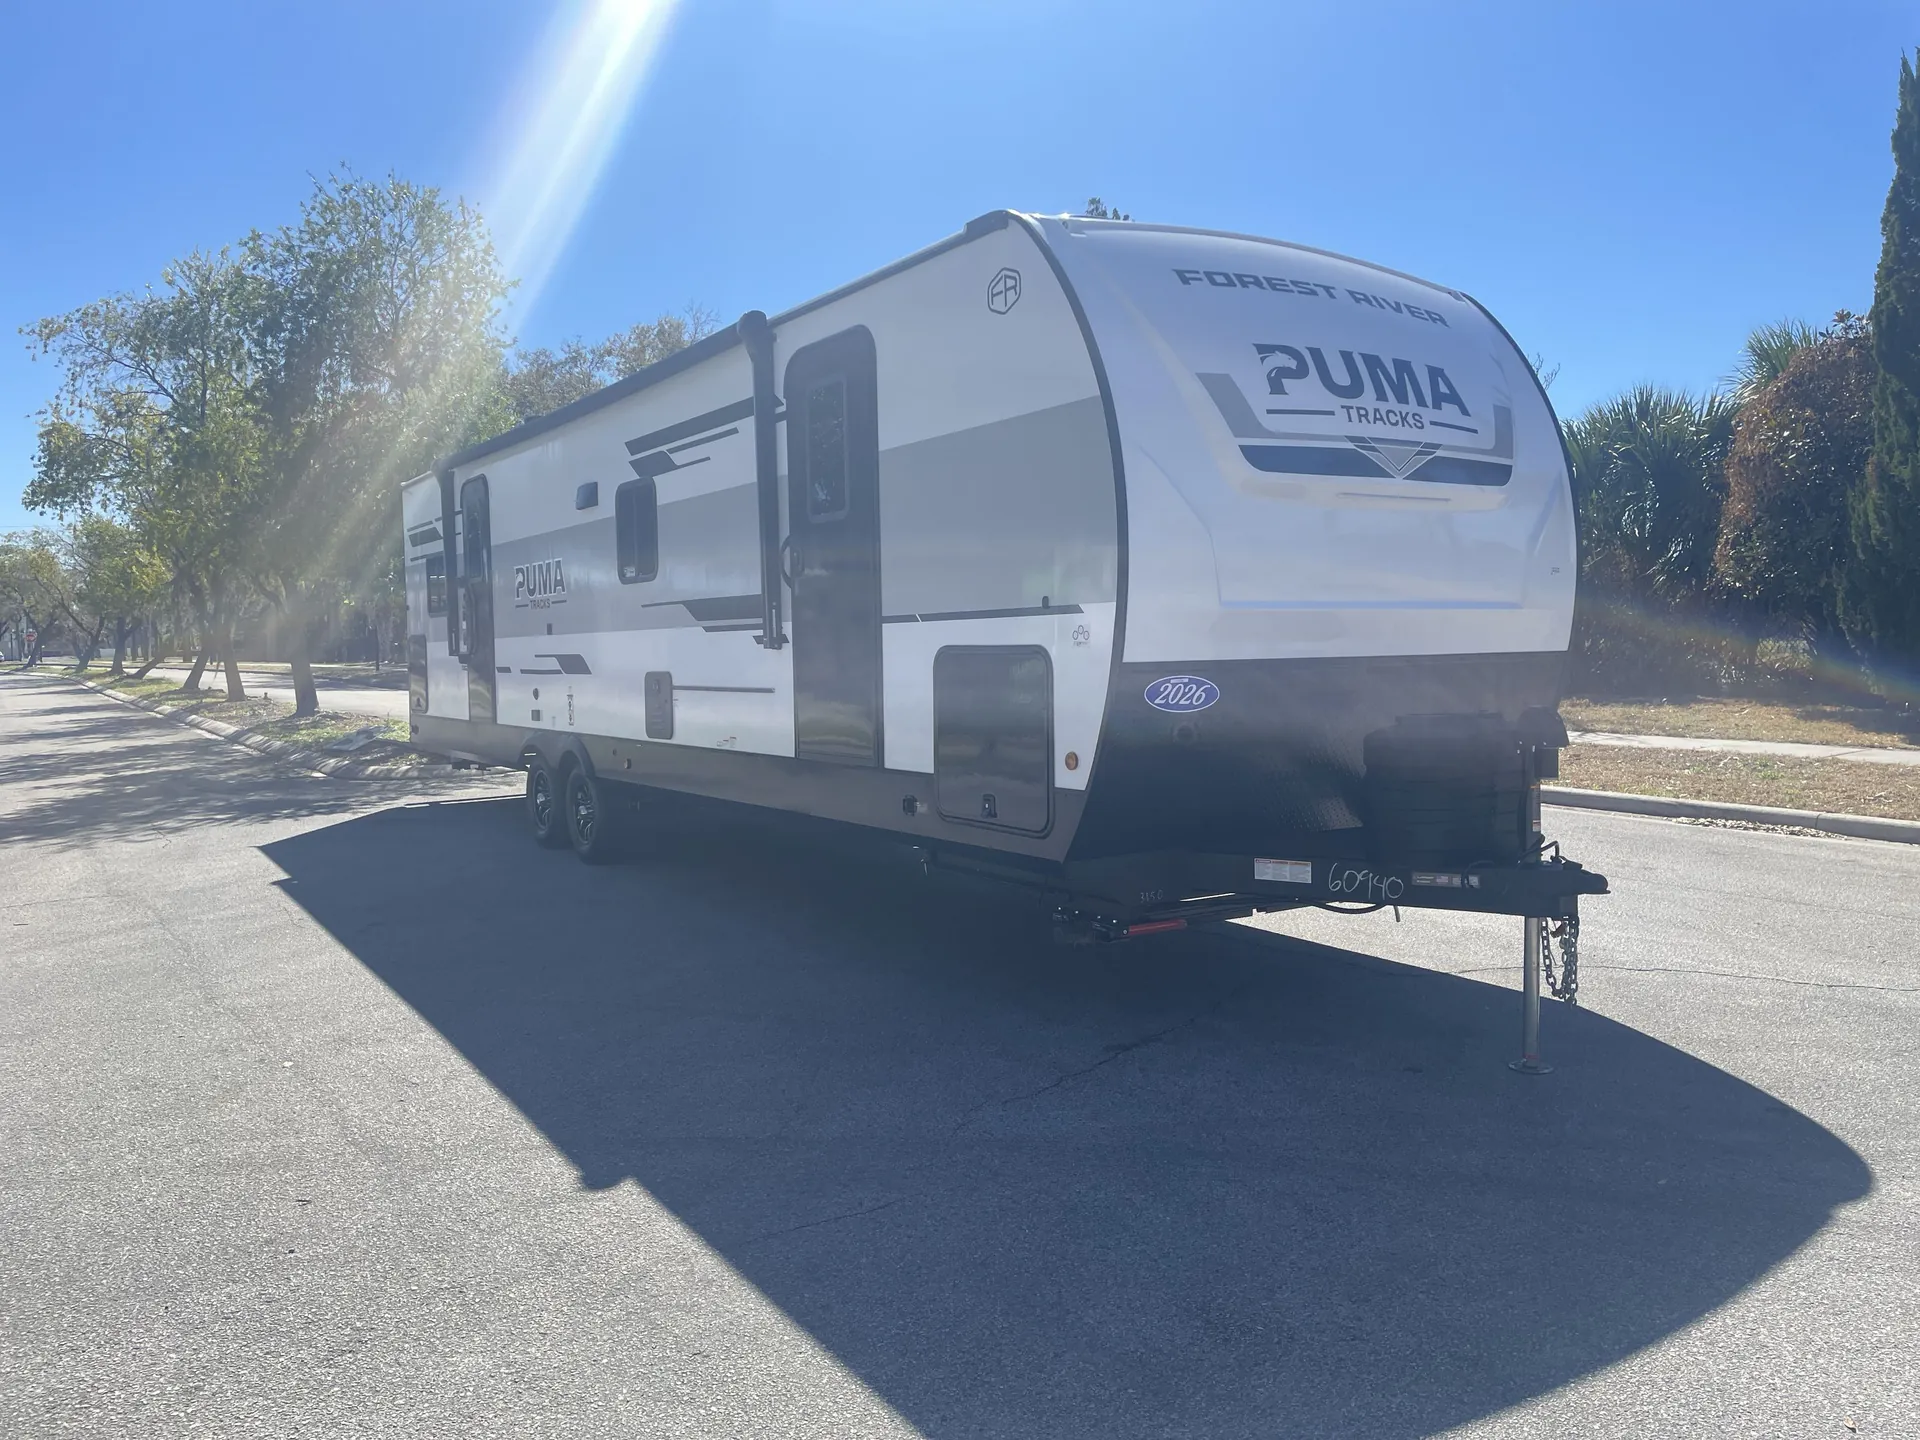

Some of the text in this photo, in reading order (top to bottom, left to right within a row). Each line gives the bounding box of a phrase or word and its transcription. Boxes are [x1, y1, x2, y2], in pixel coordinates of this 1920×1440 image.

[1172, 269, 1450, 328] FOREST RIVER
[1252, 343, 1471, 417] PUMA
[1341, 405, 1424, 430] TRACKS
[515, 558, 566, 599] PUMA
[530, 599, 550, 609] TRACKS
[1154, 683, 1210, 705] 2026
[1329, 863, 1404, 899] 60940
